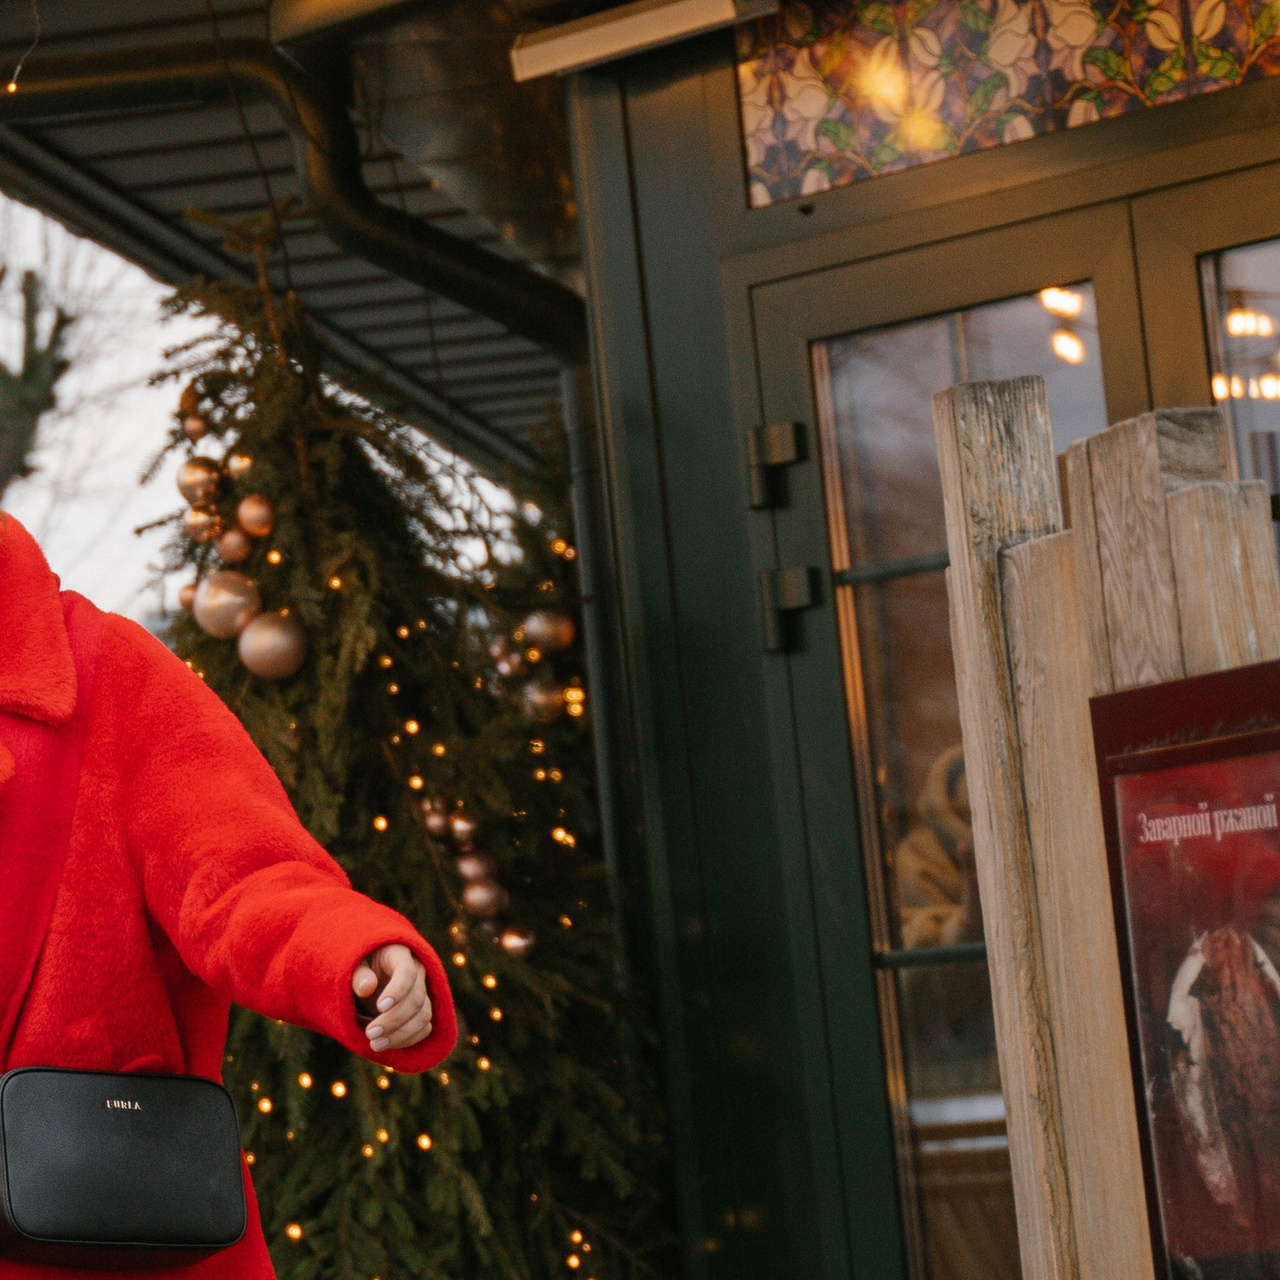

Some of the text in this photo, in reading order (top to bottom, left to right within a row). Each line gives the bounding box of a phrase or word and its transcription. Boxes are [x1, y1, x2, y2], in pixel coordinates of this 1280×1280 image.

[1138, 792, 1278, 846] Заварной ржаной
[106, 1099, 142, 1111] FURLA
